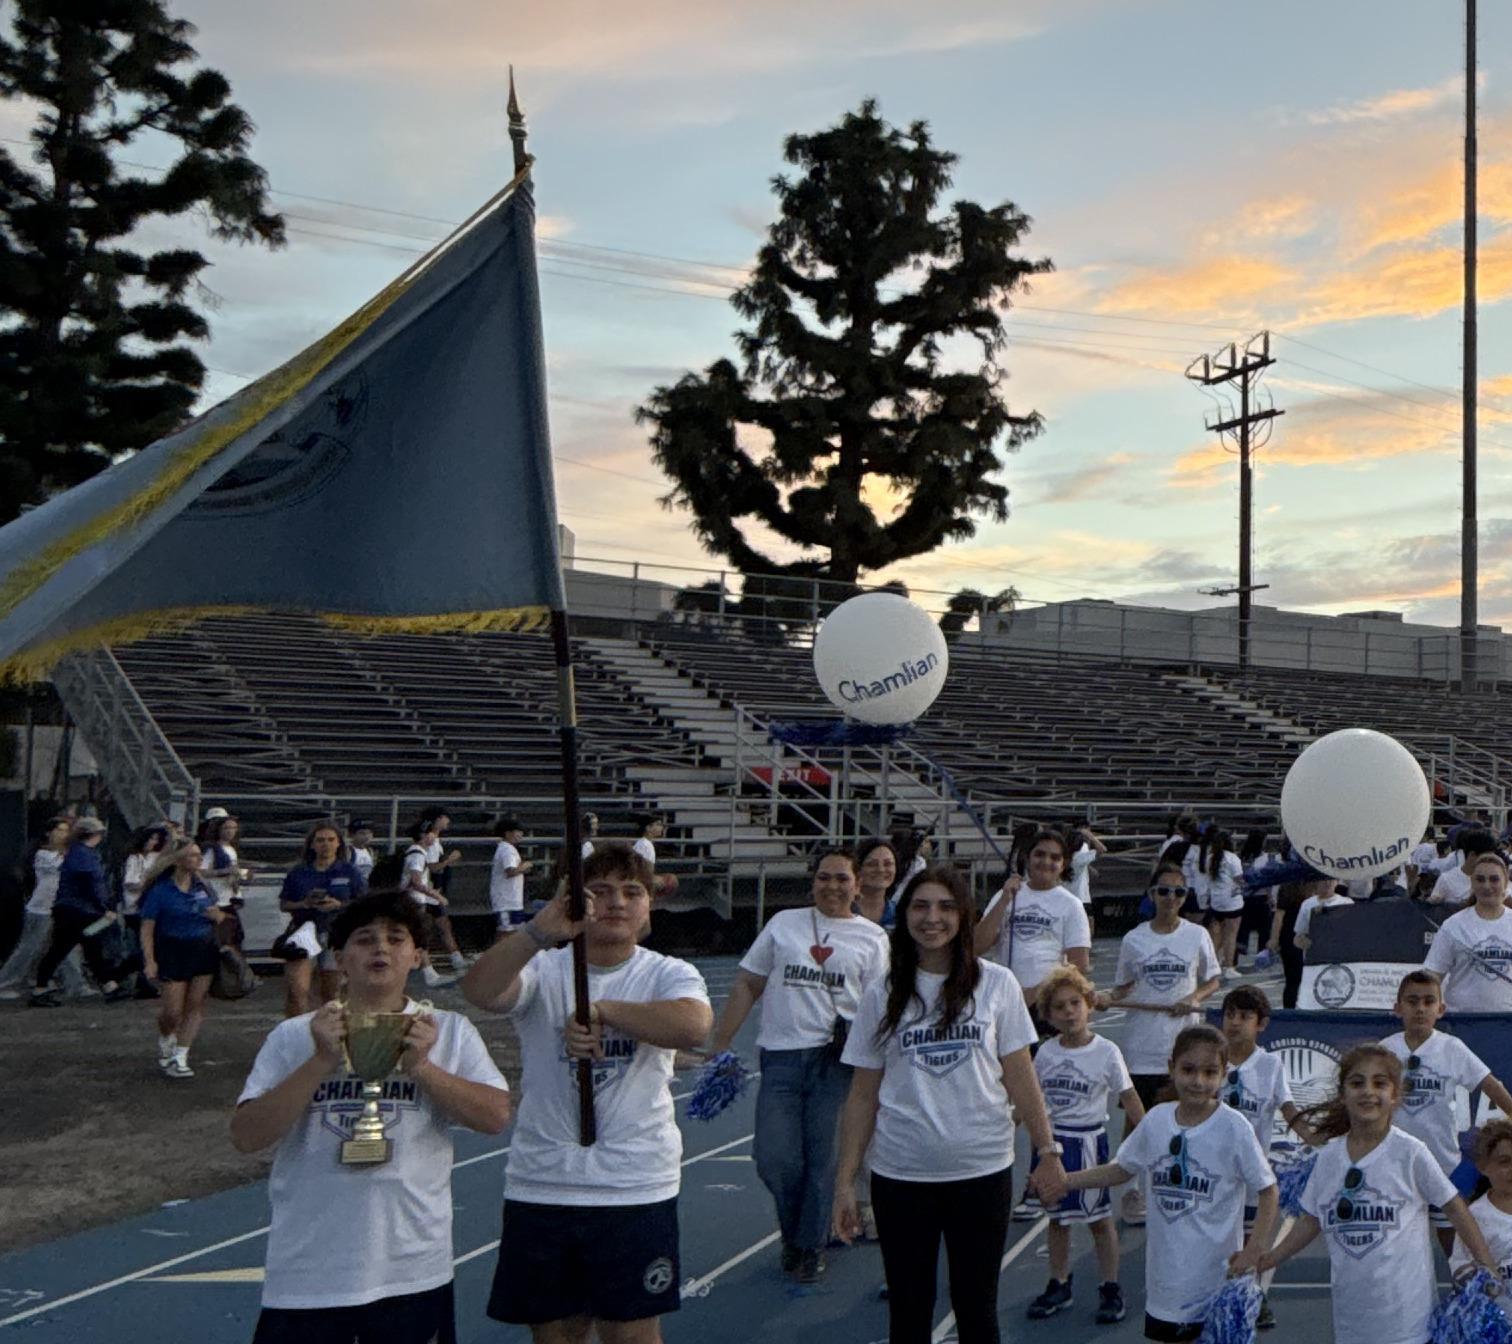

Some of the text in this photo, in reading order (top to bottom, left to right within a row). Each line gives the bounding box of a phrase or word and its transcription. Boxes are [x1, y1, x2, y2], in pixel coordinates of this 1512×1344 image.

[838, 652, 938, 704] Chamlian
[1303, 837, 1410, 869] Chamlian
[902, 1023, 981, 1049] CHAMLIAN
